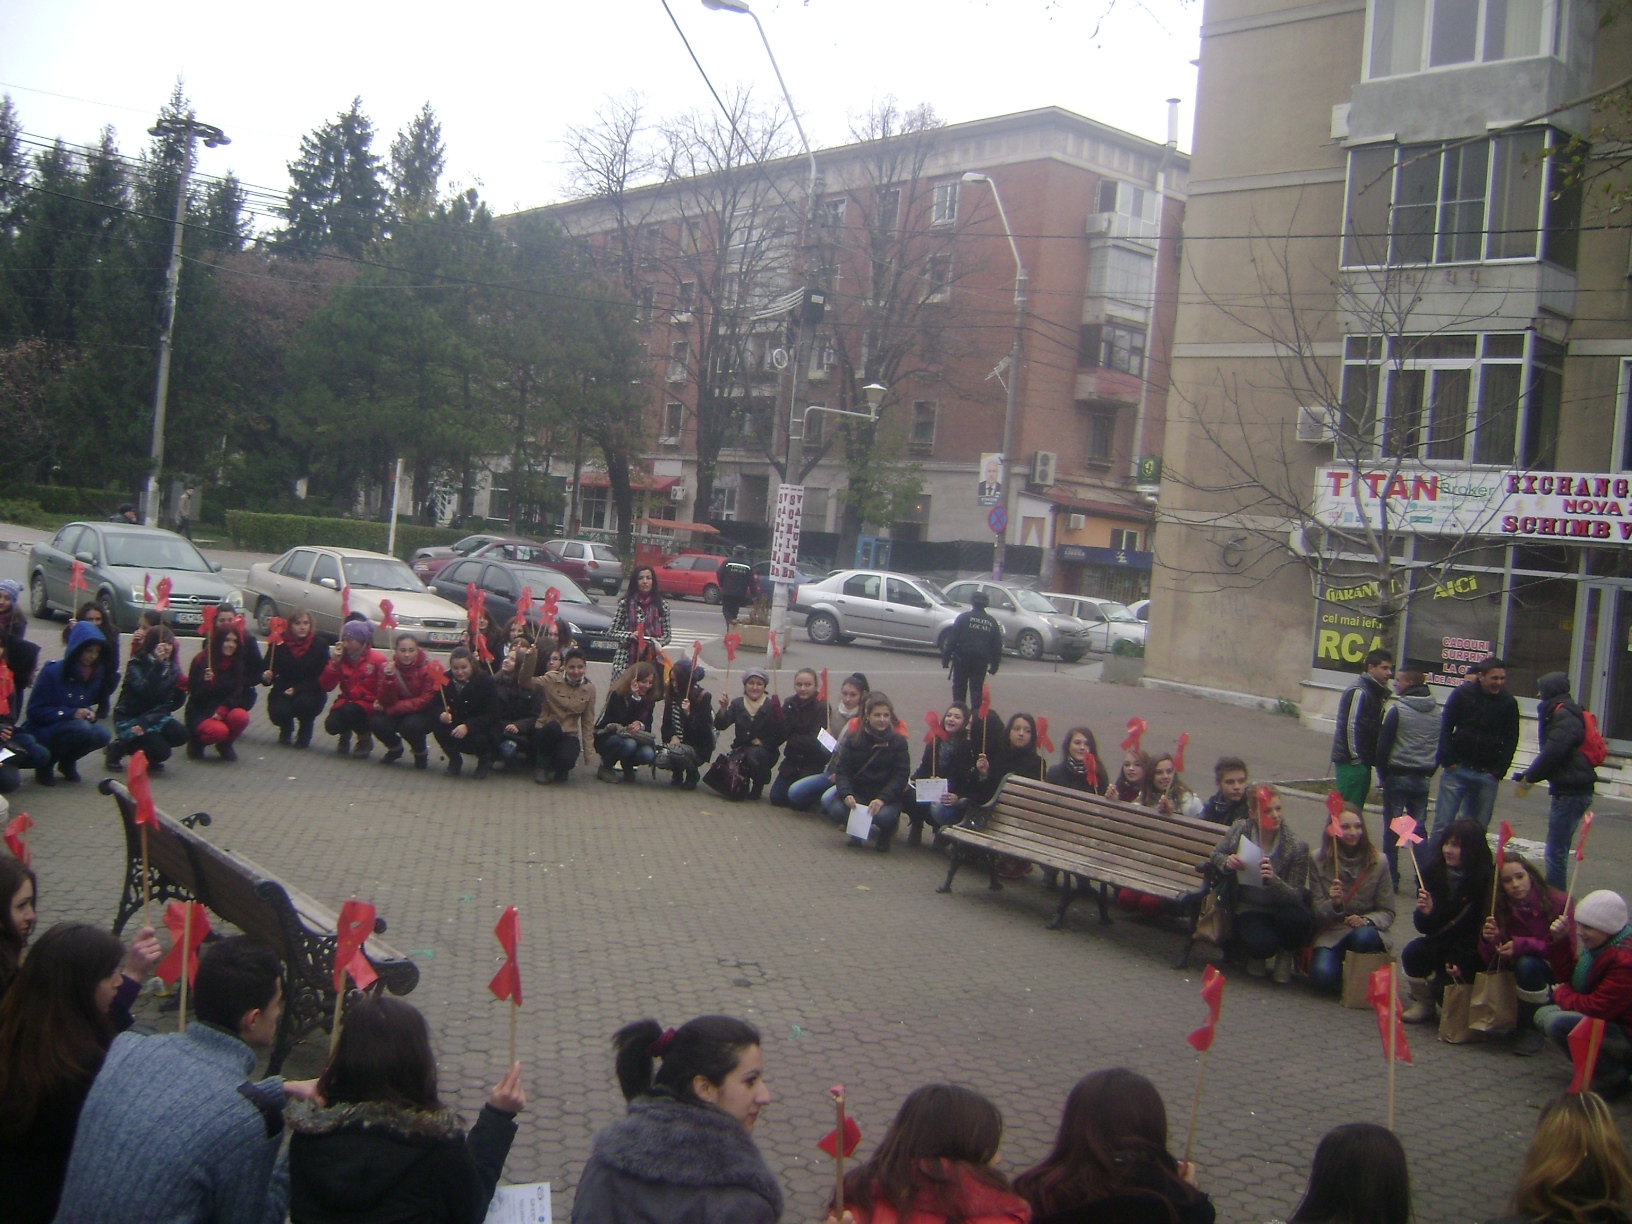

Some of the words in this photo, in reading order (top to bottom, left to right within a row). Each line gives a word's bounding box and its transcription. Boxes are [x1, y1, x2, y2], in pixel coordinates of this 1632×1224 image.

[1440, 482, 1496, 497] Broker
[1506, 474, 1632, 499] EXCHANG
[1563, 499, 1623, 516] NOVA
[1501, 515, 1611, 539] SCHIMB
[1433, 575, 1478, 600] AICI
[1322, 613, 1338, 624] cel
[1340, 616, 1360, 626] mai
[1442, 637, 1490, 652] CADOURI
[1442, 663, 1458, 674] LA
[1434, 674, 1446, 684] DE
